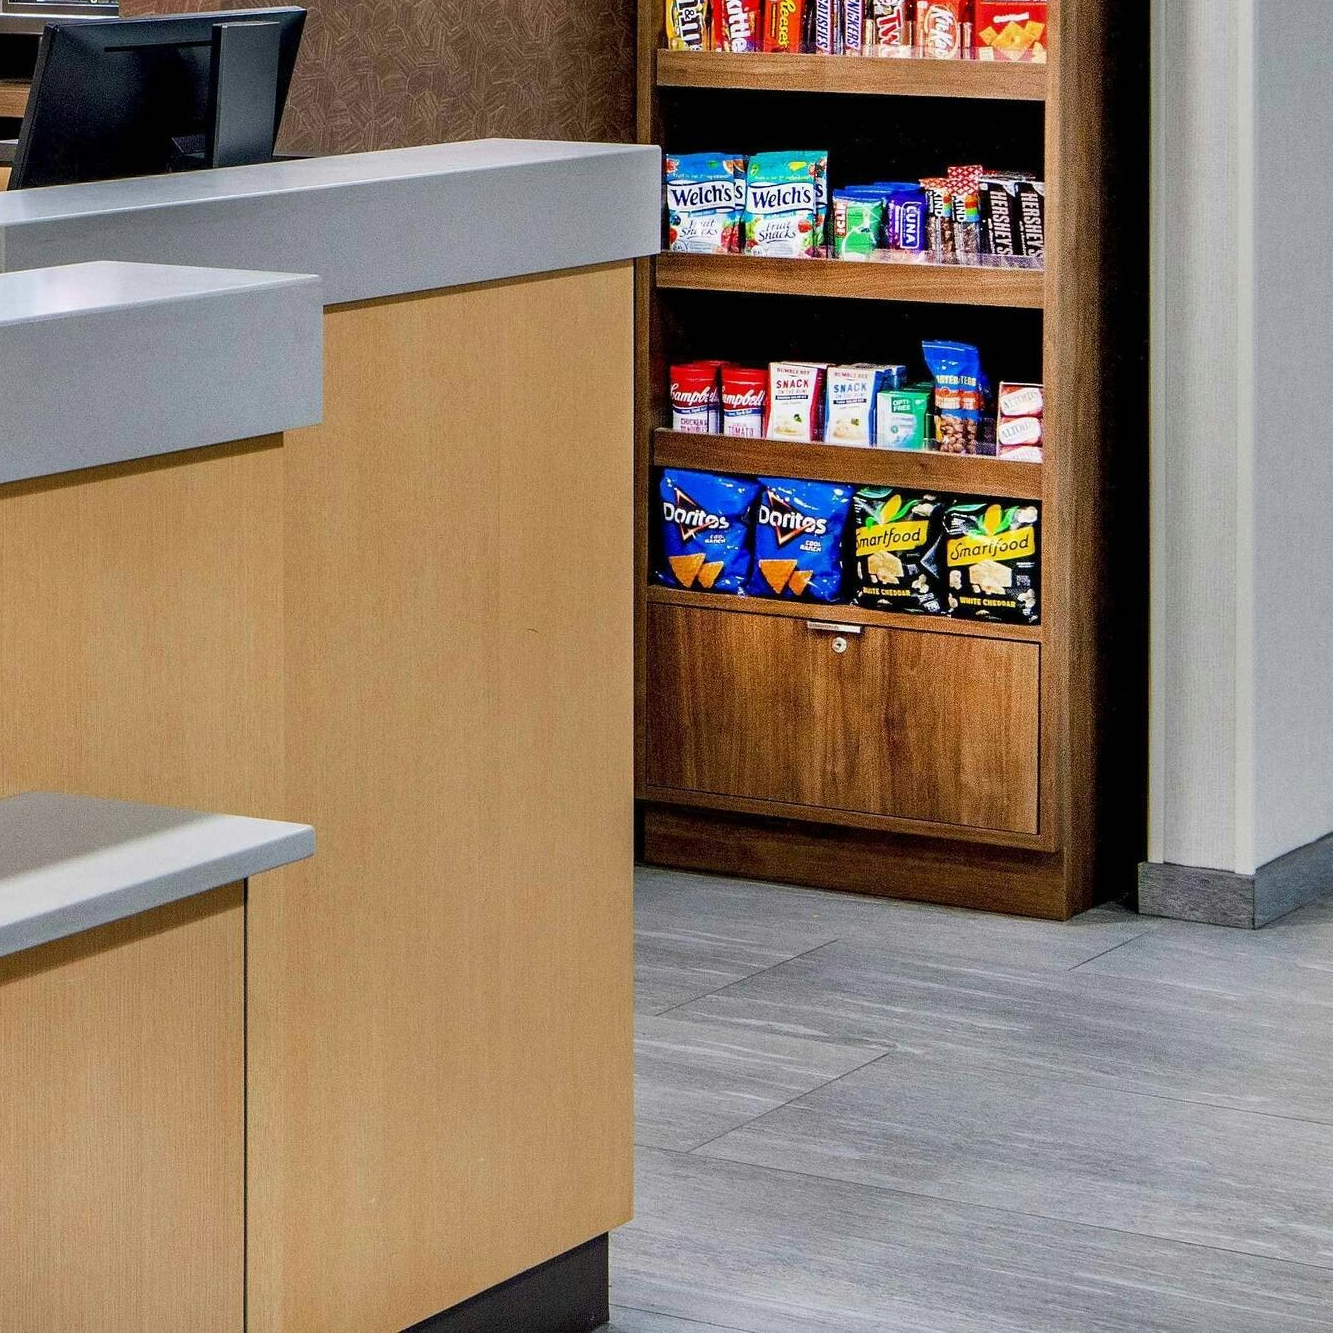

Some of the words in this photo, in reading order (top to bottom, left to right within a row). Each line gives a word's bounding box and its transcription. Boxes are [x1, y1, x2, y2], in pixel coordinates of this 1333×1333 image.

[670, 185, 732, 206] Welch's
[752, 186, 811, 208] Welch's
[933, 191, 942, 217] KIND
[955, 195, 965, 222] KIND
[905, 205, 916, 244] LUNA
[990, 191, 1013, 256] HERSHEY'S
[776, 379, 809, 388] SNACK
[834, 382, 867, 393] SNACK
[663, 502, 730, 529] Doritos
[758, 505, 827, 534] Doritos
[950, 535, 1030, 560] Smartfood
[881, 588, 911, 597] CHEDDAR
[959, 596, 982, 606] WHITE
[983, 598, 1017, 608] CHEDDAR
